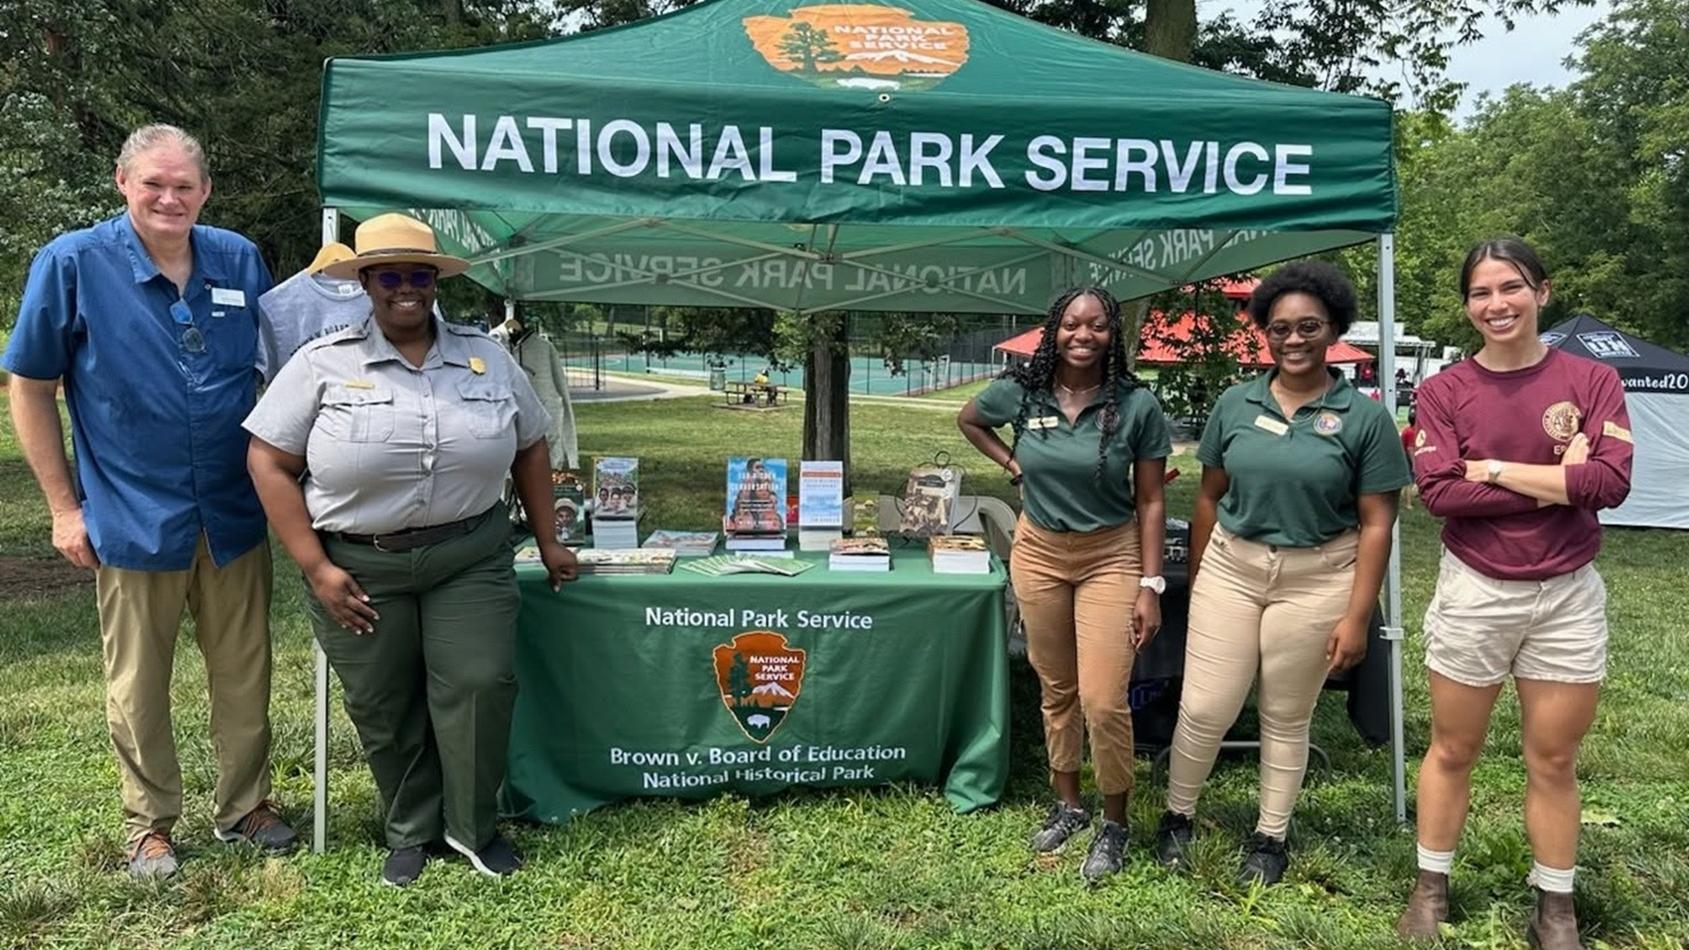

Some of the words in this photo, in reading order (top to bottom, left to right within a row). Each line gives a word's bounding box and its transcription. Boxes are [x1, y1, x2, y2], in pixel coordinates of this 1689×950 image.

[834, 25, 954, 35] NATIONAL
[865, 34, 927, 42] PARK
[850, 41, 948, 50] SERVICE
[428, 113, 797, 182] NATIONAL
[821, 129, 1005, 188] PARK
[1025, 135, 1313, 195] SERVICE
[645, 607, 735, 627] National
[741, 609, 788, 627] Park
[797, 610, 873, 629] Service
[750, 655, 800, 664] NATIONAL
[762, 664, 788, 672] PARK
[754, 672, 795, 681] SERVICE
[610, 747, 679, 766] Brown
[686, 752, 702, 765] v.
[710, 746, 771, 765] Board
[778, 744, 802, 762] of
[808, 744, 906, 762] Education
[643, 770, 729, 789] National
[735, 766, 825, 784] Historical
[832, 765, 875, 780] Park
